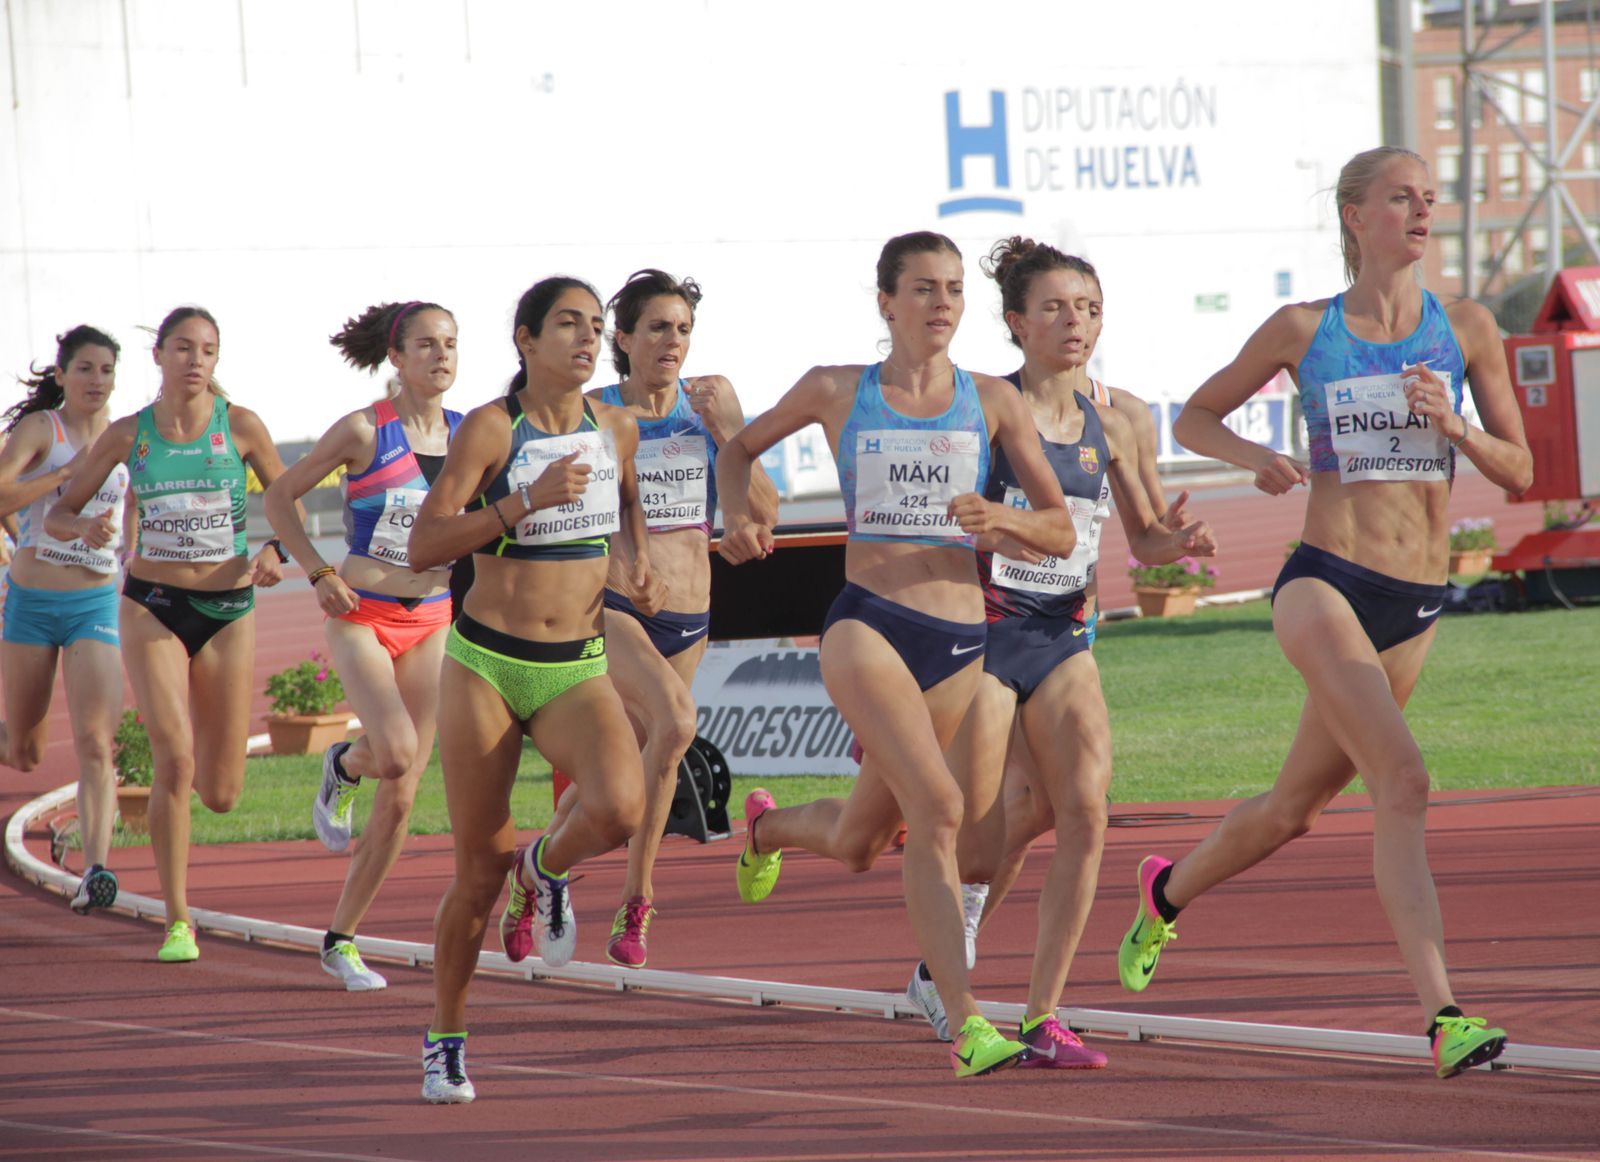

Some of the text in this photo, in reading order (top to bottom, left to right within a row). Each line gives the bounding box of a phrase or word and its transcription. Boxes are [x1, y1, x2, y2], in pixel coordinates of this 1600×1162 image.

[1022, 77, 1217, 133] DIPUTACIÓN
[1024, 145, 1201, 191] DE HUELVA
[1335, 410, 1428, 436] ENGLA
[1389, 436, 1401, 453] 2
[889, 460, 949, 483] MÄKI
[1347, 456, 1446, 473] BRIDGESTONE
[558, 499, 584, 514] 409
[643, 493, 667, 505] 431
[900, 495, 928, 508] 424
[141, 513, 229, 533] RODRÍGUEZ
[389, 512, 415, 528] LO
[524, 511, 616, 537] BRIDGESTONE
[863, 510, 961, 527] BRIDGESTON
[70, 542, 90, 554] 444
[177, 536, 194, 547] 39
[42, 548, 112, 568] BRIDGESTONE
[147, 546, 229, 560] BRIDGESTONE
[374, 546, 408, 562] BRID
[999, 563, 1083, 588] BRIDGESTONE
[696, 705, 853, 758] RIDGESTON
